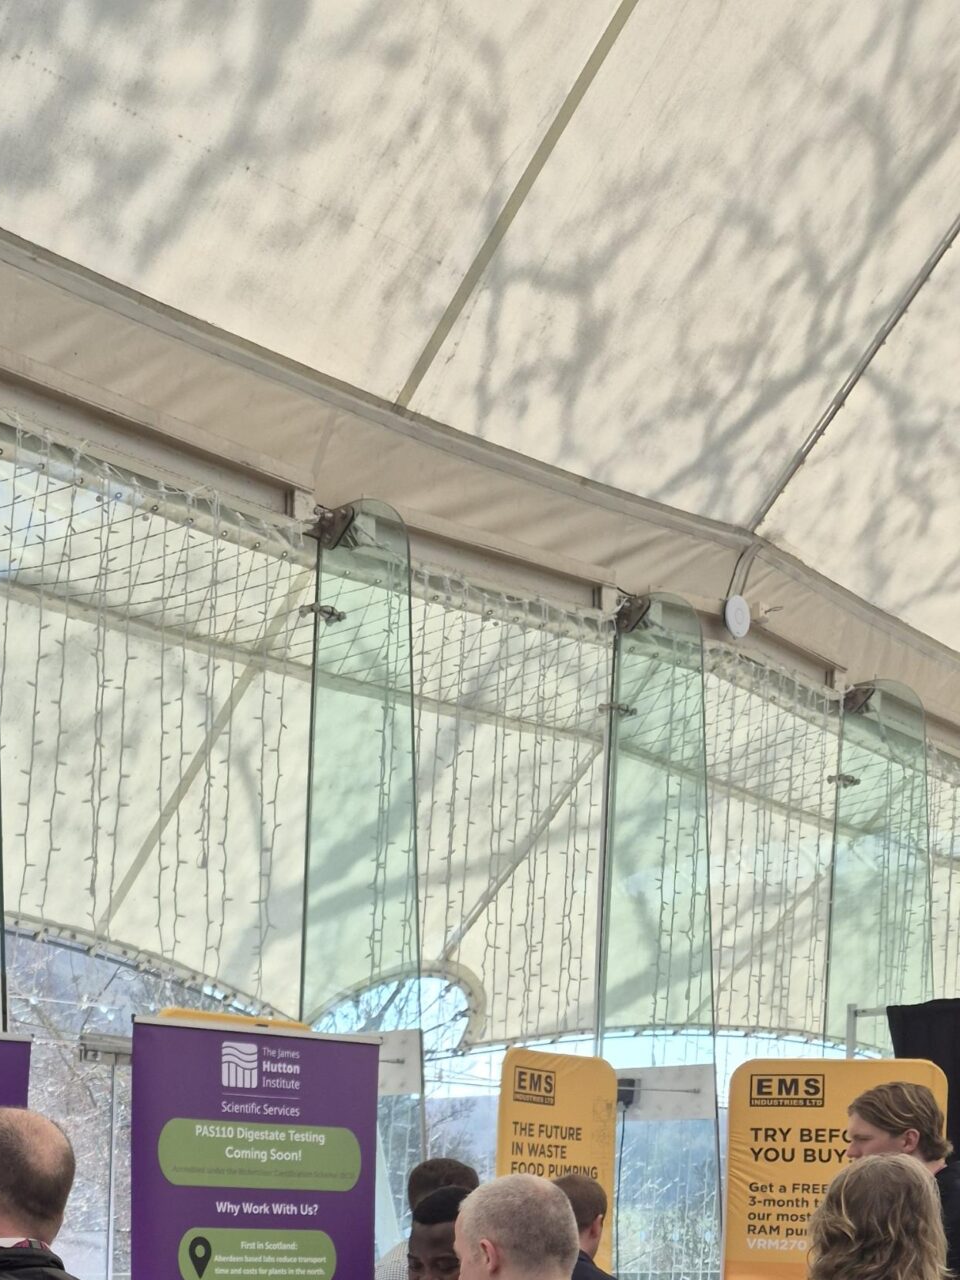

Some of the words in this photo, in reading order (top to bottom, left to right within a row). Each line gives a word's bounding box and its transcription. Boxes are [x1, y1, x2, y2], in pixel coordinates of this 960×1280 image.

[263, 1047, 276, 1058] The
[276, 1048, 300, 1060] James
[262, 1061, 300, 1074] Hutton
[262, 1077, 300, 1090] Institute
[518, 1071, 553, 1093] EMS
[757, 1078, 820, 1096] EMS
[221, 1101, 261, 1115] Scientific
[263, 1104, 300, 1117] Services
[195, 1125, 234, 1138] PAS110
[237, 1128, 286, 1142] Digestate
[289, 1130, 325, 1145] Testing
[512, 1121, 535, 1137] THE
[539, 1124, 582, 1141] FUTURE
[750, 1128, 791, 1142] TRY
[225, 1147, 267, 1162] Coming
[270, 1149, 302, 1161] Soon!
[512, 1142, 523, 1156] IN
[528, 1143, 567, 1159] WASTE
[750, 1148, 795, 1162] YOU
[511, 1162, 544, 1176] FOOD
[549, 1164, 598, 1179] PUMPING
[749, 1182, 774, 1192] Get
[779, 1185, 786, 1193] a
[792, 1183, 829, 1194] FREE
[216, 1201, 239, 1216] Why
[242, 1202, 269, 1215] Work
[272, 1203, 297, 1215] With
[300, 1204, 319, 1216] Us?
[749, 1196, 809, 1208] 3-month
[748, 1212, 772, 1221] our
[777, 1212, 811, 1222] most
[747, 1224, 780, 1235] RAM
[240, 1241, 255, 1250] First
[257, 1241, 264, 1249] in
[265, 1241, 298, 1250] Scotland:
[746, 1239, 807, 1250] VRM270
[268, 1268, 287, 1276] plants
